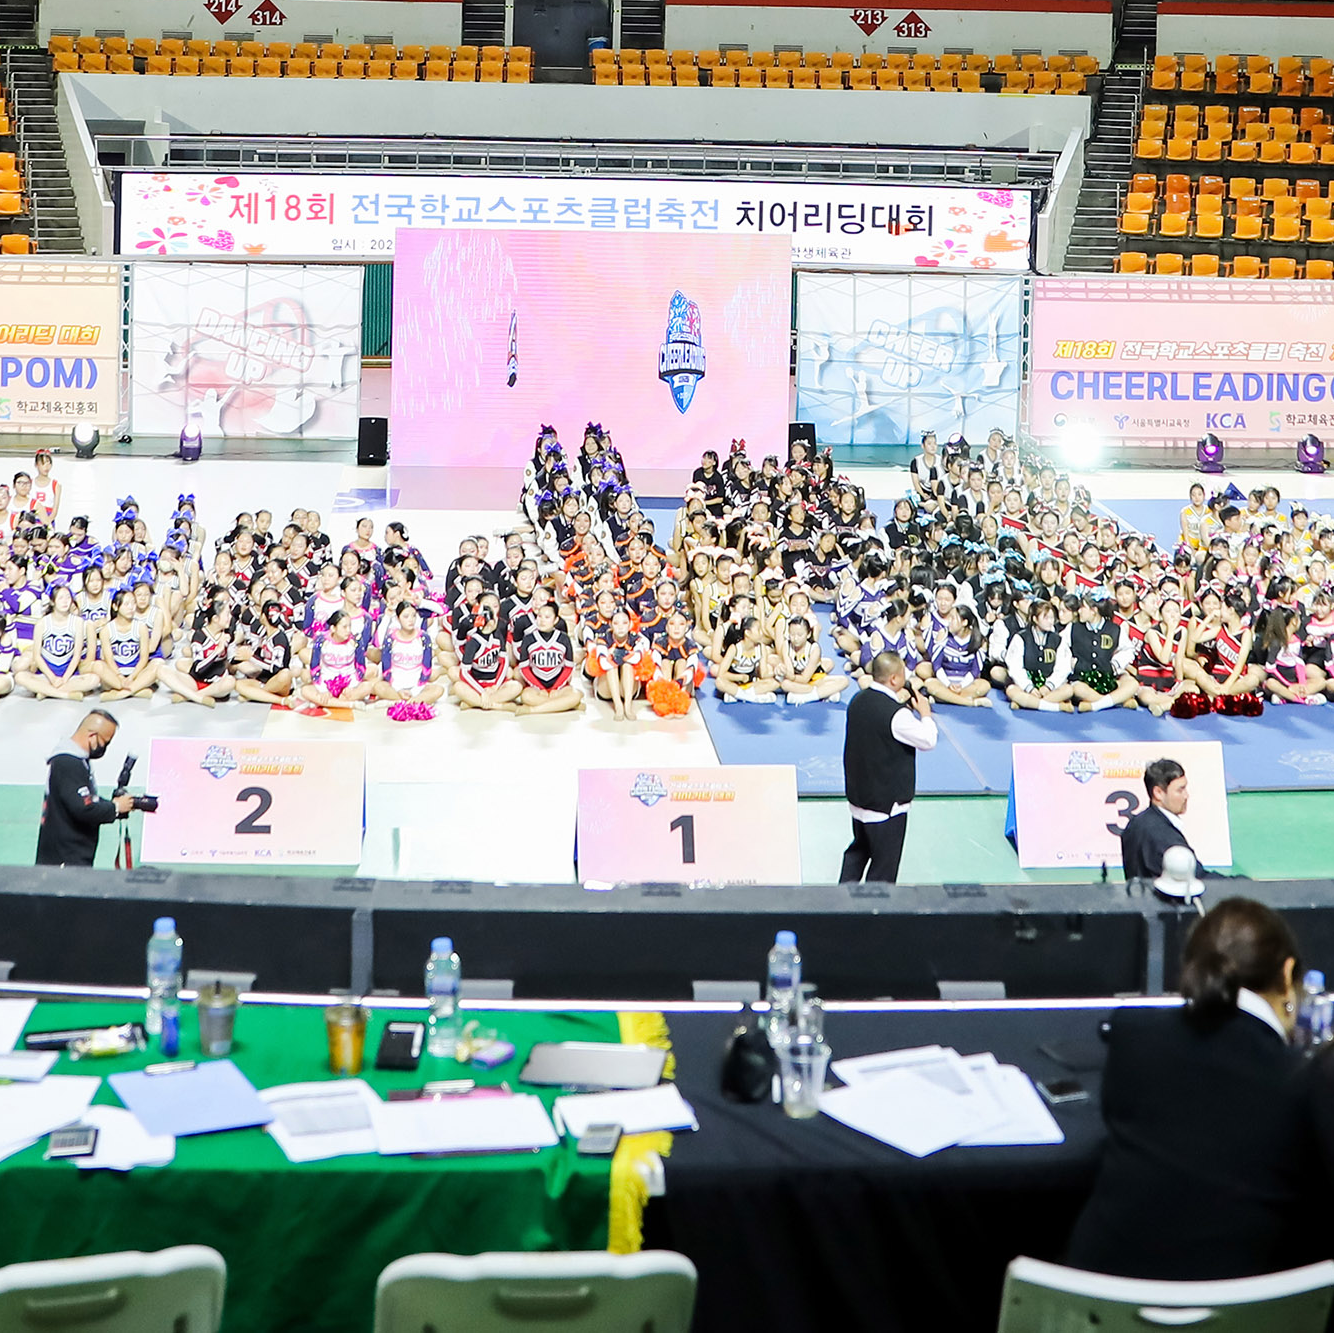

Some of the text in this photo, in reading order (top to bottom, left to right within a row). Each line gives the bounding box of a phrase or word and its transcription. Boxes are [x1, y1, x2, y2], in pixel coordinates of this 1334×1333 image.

[254, 10, 281, 26] 314
[855, 9, 883, 25] 213
[898, 22, 926, 38] 313
[228, 192, 335, 226] 제18회
[331, 238, 357, 251] 일시
[370, 239, 395, 251] 202
[791, 246, 852, 260] 학생체육관
[57, 324, 101, 346] 대회
[197, 309, 314, 372] DANCING
[868, 320, 956, 373] CHEER
[1053, 339, 1114, 360] 제18회
[1119, 340, 1285, 362] 전국학교스포츠클럽
[1287, 342, 1326, 362] 축전
[226, 351, 267, 384] UP
[882, 356, 923, 390] UP
[16, 399, 99, 415] 학교체육진흥회
[1131, 417, 1191, 429] 서울특별시교육청
[1205, 411, 1247, 429] KCA
[1100, 634, 1113, 650] D
[1043, 648, 1056, 664] D
[234, 786, 273, 835] 2
[1104, 790, 1140, 836] 3
[670, 814, 696, 864] 1
